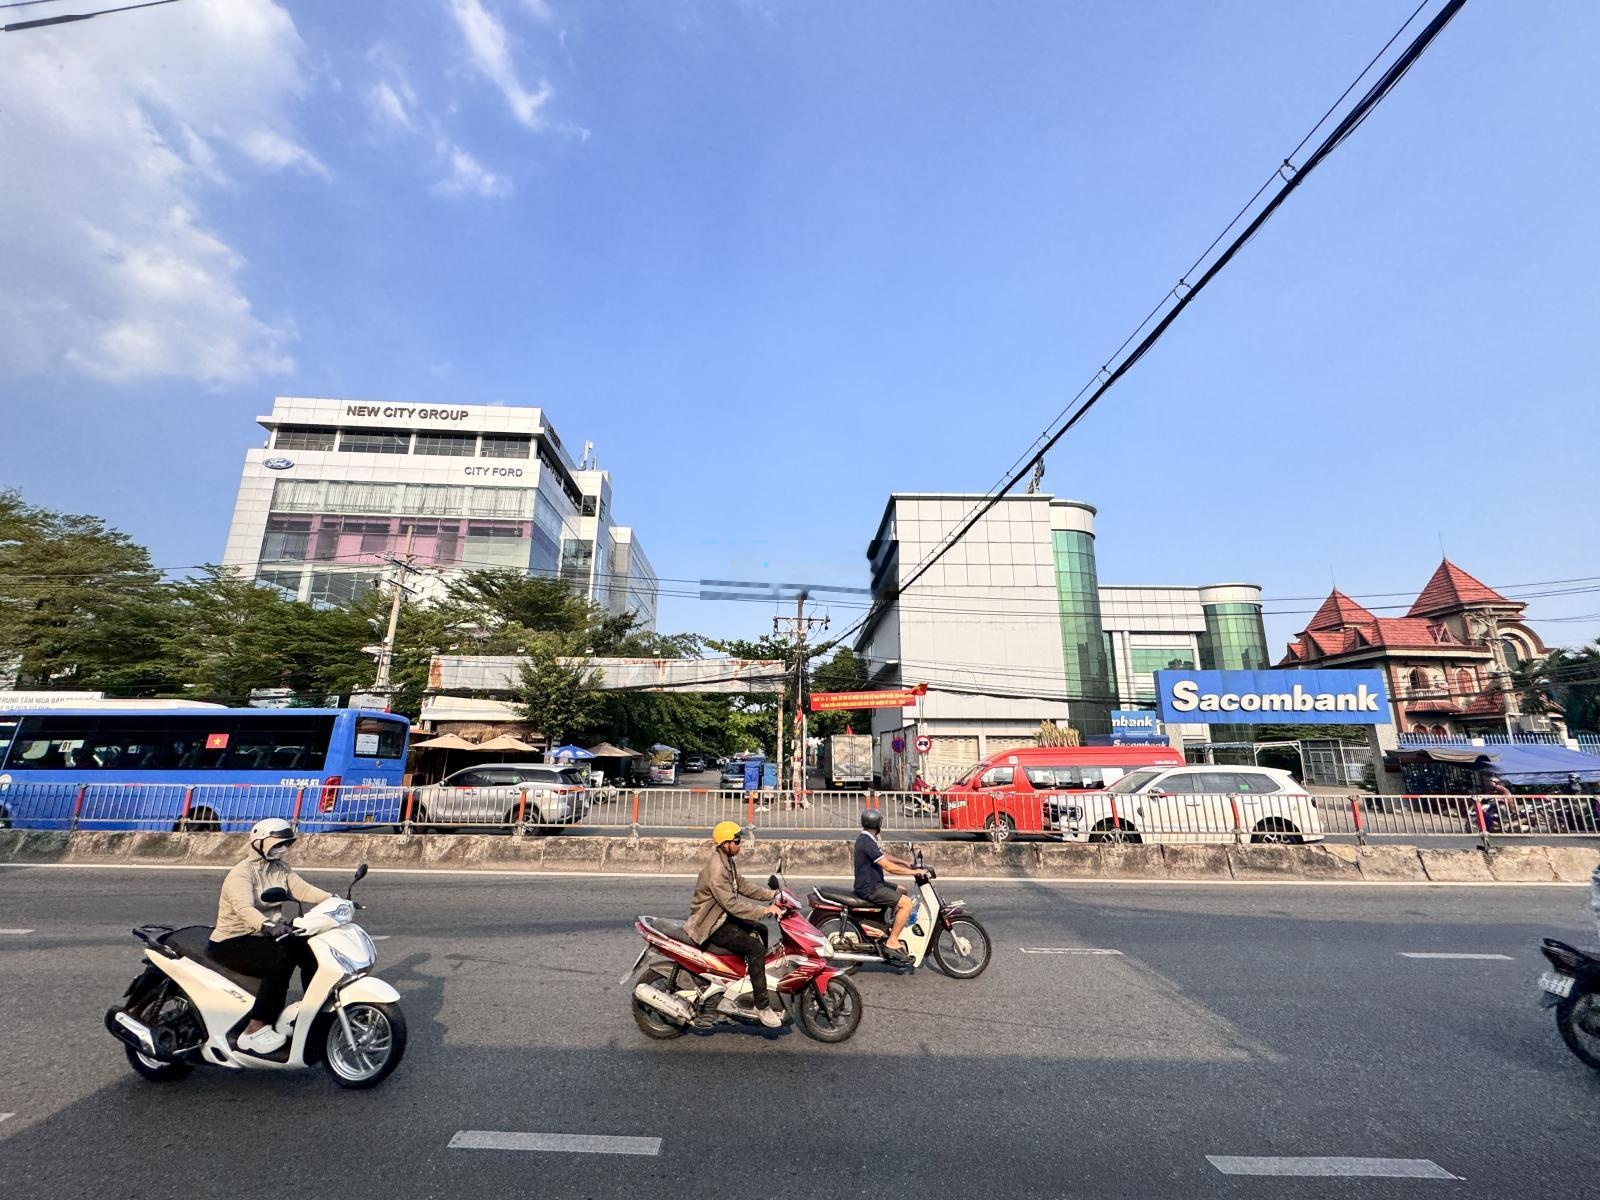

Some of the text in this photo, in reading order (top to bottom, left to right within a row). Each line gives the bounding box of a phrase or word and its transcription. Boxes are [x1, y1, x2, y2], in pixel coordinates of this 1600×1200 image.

[347, 405, 469, 421] NEW CITY GROUP
[464, 466, 523, 477] CITY FORD
[1172, 680, 1379, 712] Sacombank
[62, 741, 72, 751] 91
